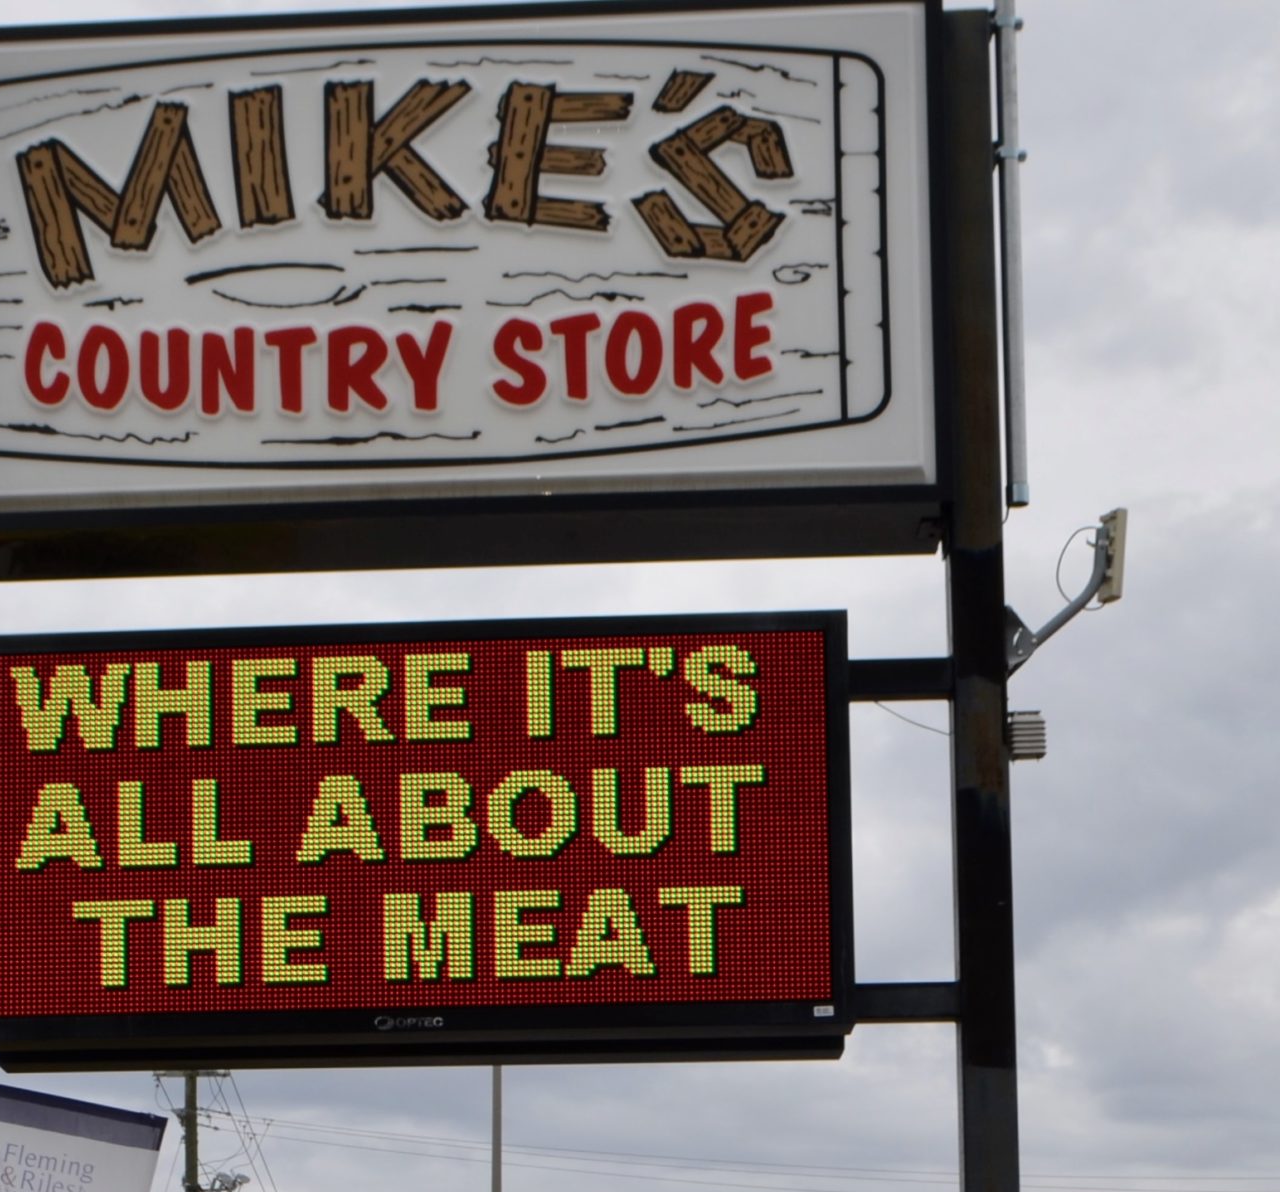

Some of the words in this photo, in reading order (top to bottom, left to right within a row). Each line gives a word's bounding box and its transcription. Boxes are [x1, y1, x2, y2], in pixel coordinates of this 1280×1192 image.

[14, 68, 795, 290] MIKE'S
[23, 320, 454, 414] COUNTRY
[491, 291, 774, 406] STORE
[10, 652, 471, 751] WHERE
[525, 644, 760, 739] IT'S
[15, 777, 253, 870] ALL
[296, 765, 765, 863] ABOUT
[72, 894, 329, 988] THE
[382, 885, 744, 982] MEAT
[4, 1143, 95, 1184] Fleming
